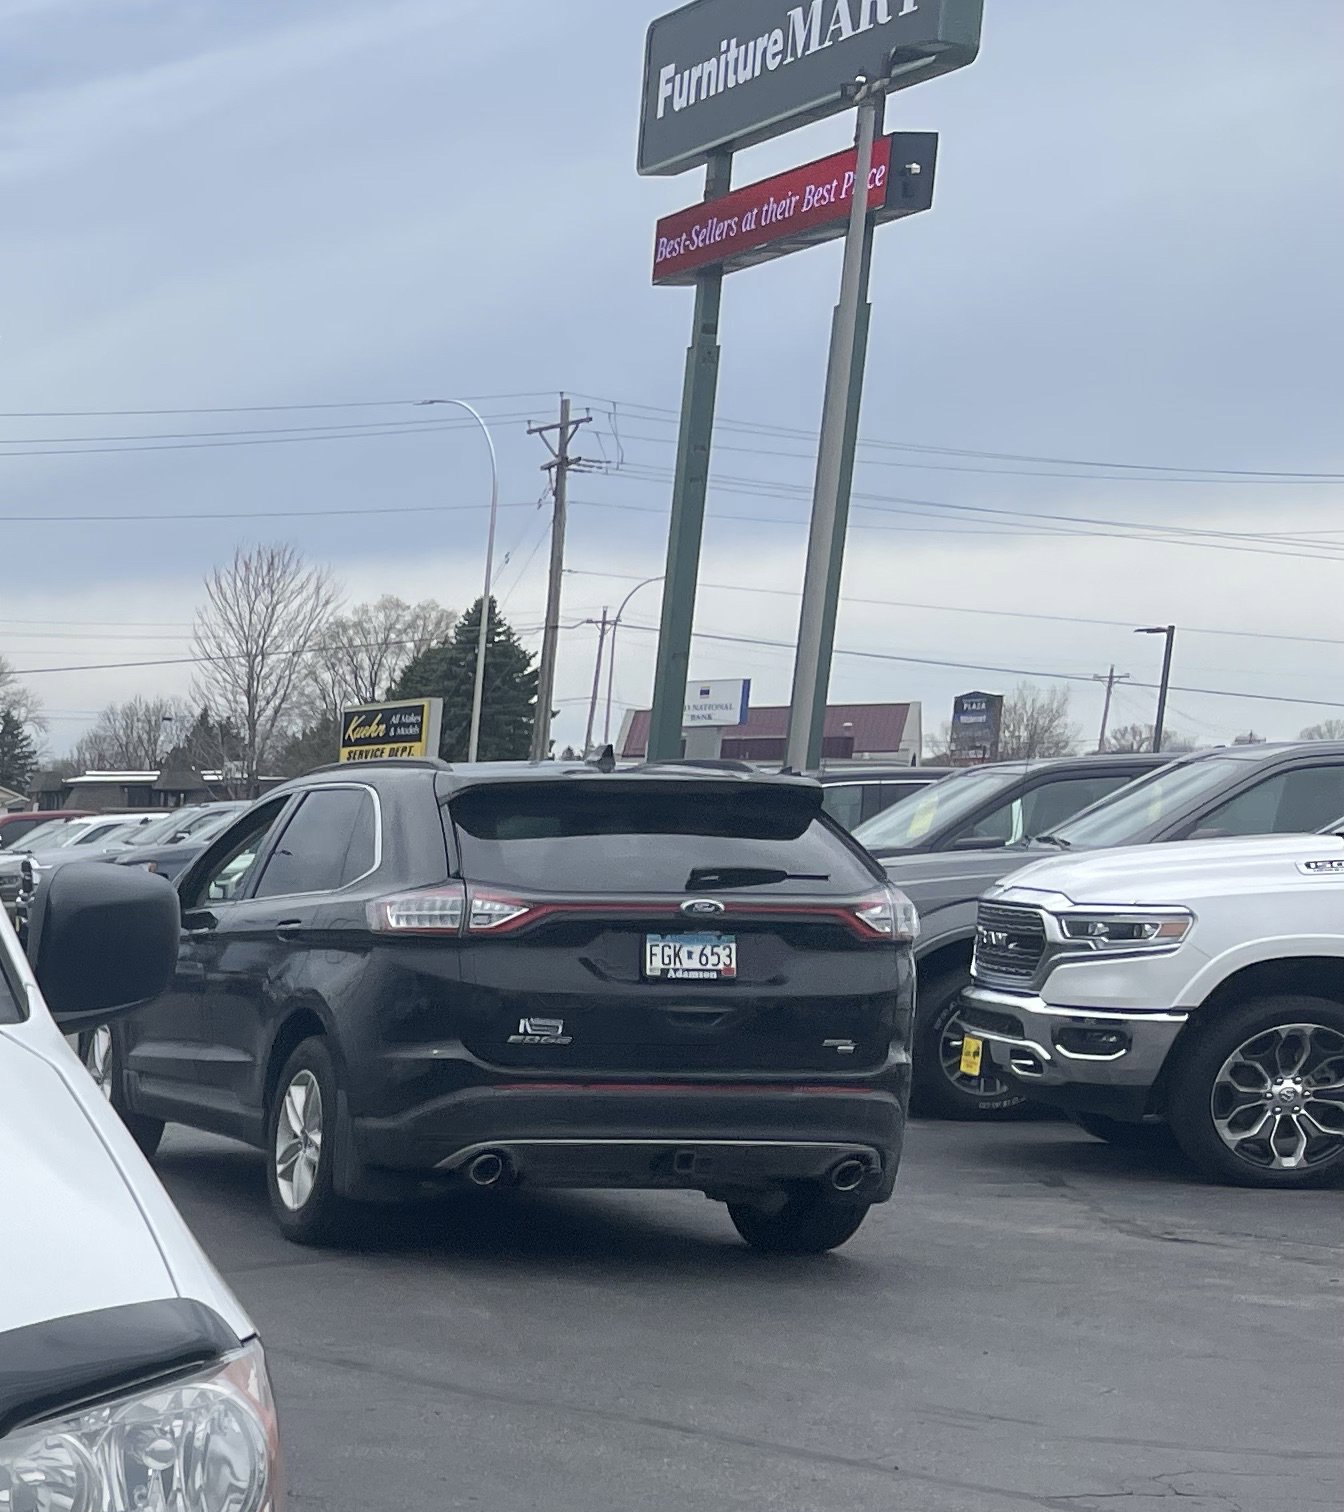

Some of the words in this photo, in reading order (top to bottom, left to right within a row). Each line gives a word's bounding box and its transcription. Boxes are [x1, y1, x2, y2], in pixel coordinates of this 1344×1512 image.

[657, 0, 919, 119] FurnitureMAR
[656, 215, 739, 263] Best-Sellers
[742, 208, 759, 232] at
[761, 191, 800, 228] their
[801, 179, 838, 213] Best
[840, 165, 886, 199] Pce
[963, 702, 986, 710] PLAZA
[390, 713, 400, 724] All
[402, 712, 421, 724] Makes
[691, 713, 712, 721] BANK
[344, 712, 387, 742] Kuehn
[396, 725, 420, 736] Models
[347, 747, 386, 760] SERVICE
[388, 746, 415, 758] DEPT.
[649, 944, 683, 967] FGK
[699, 944, 732, 967] 653
